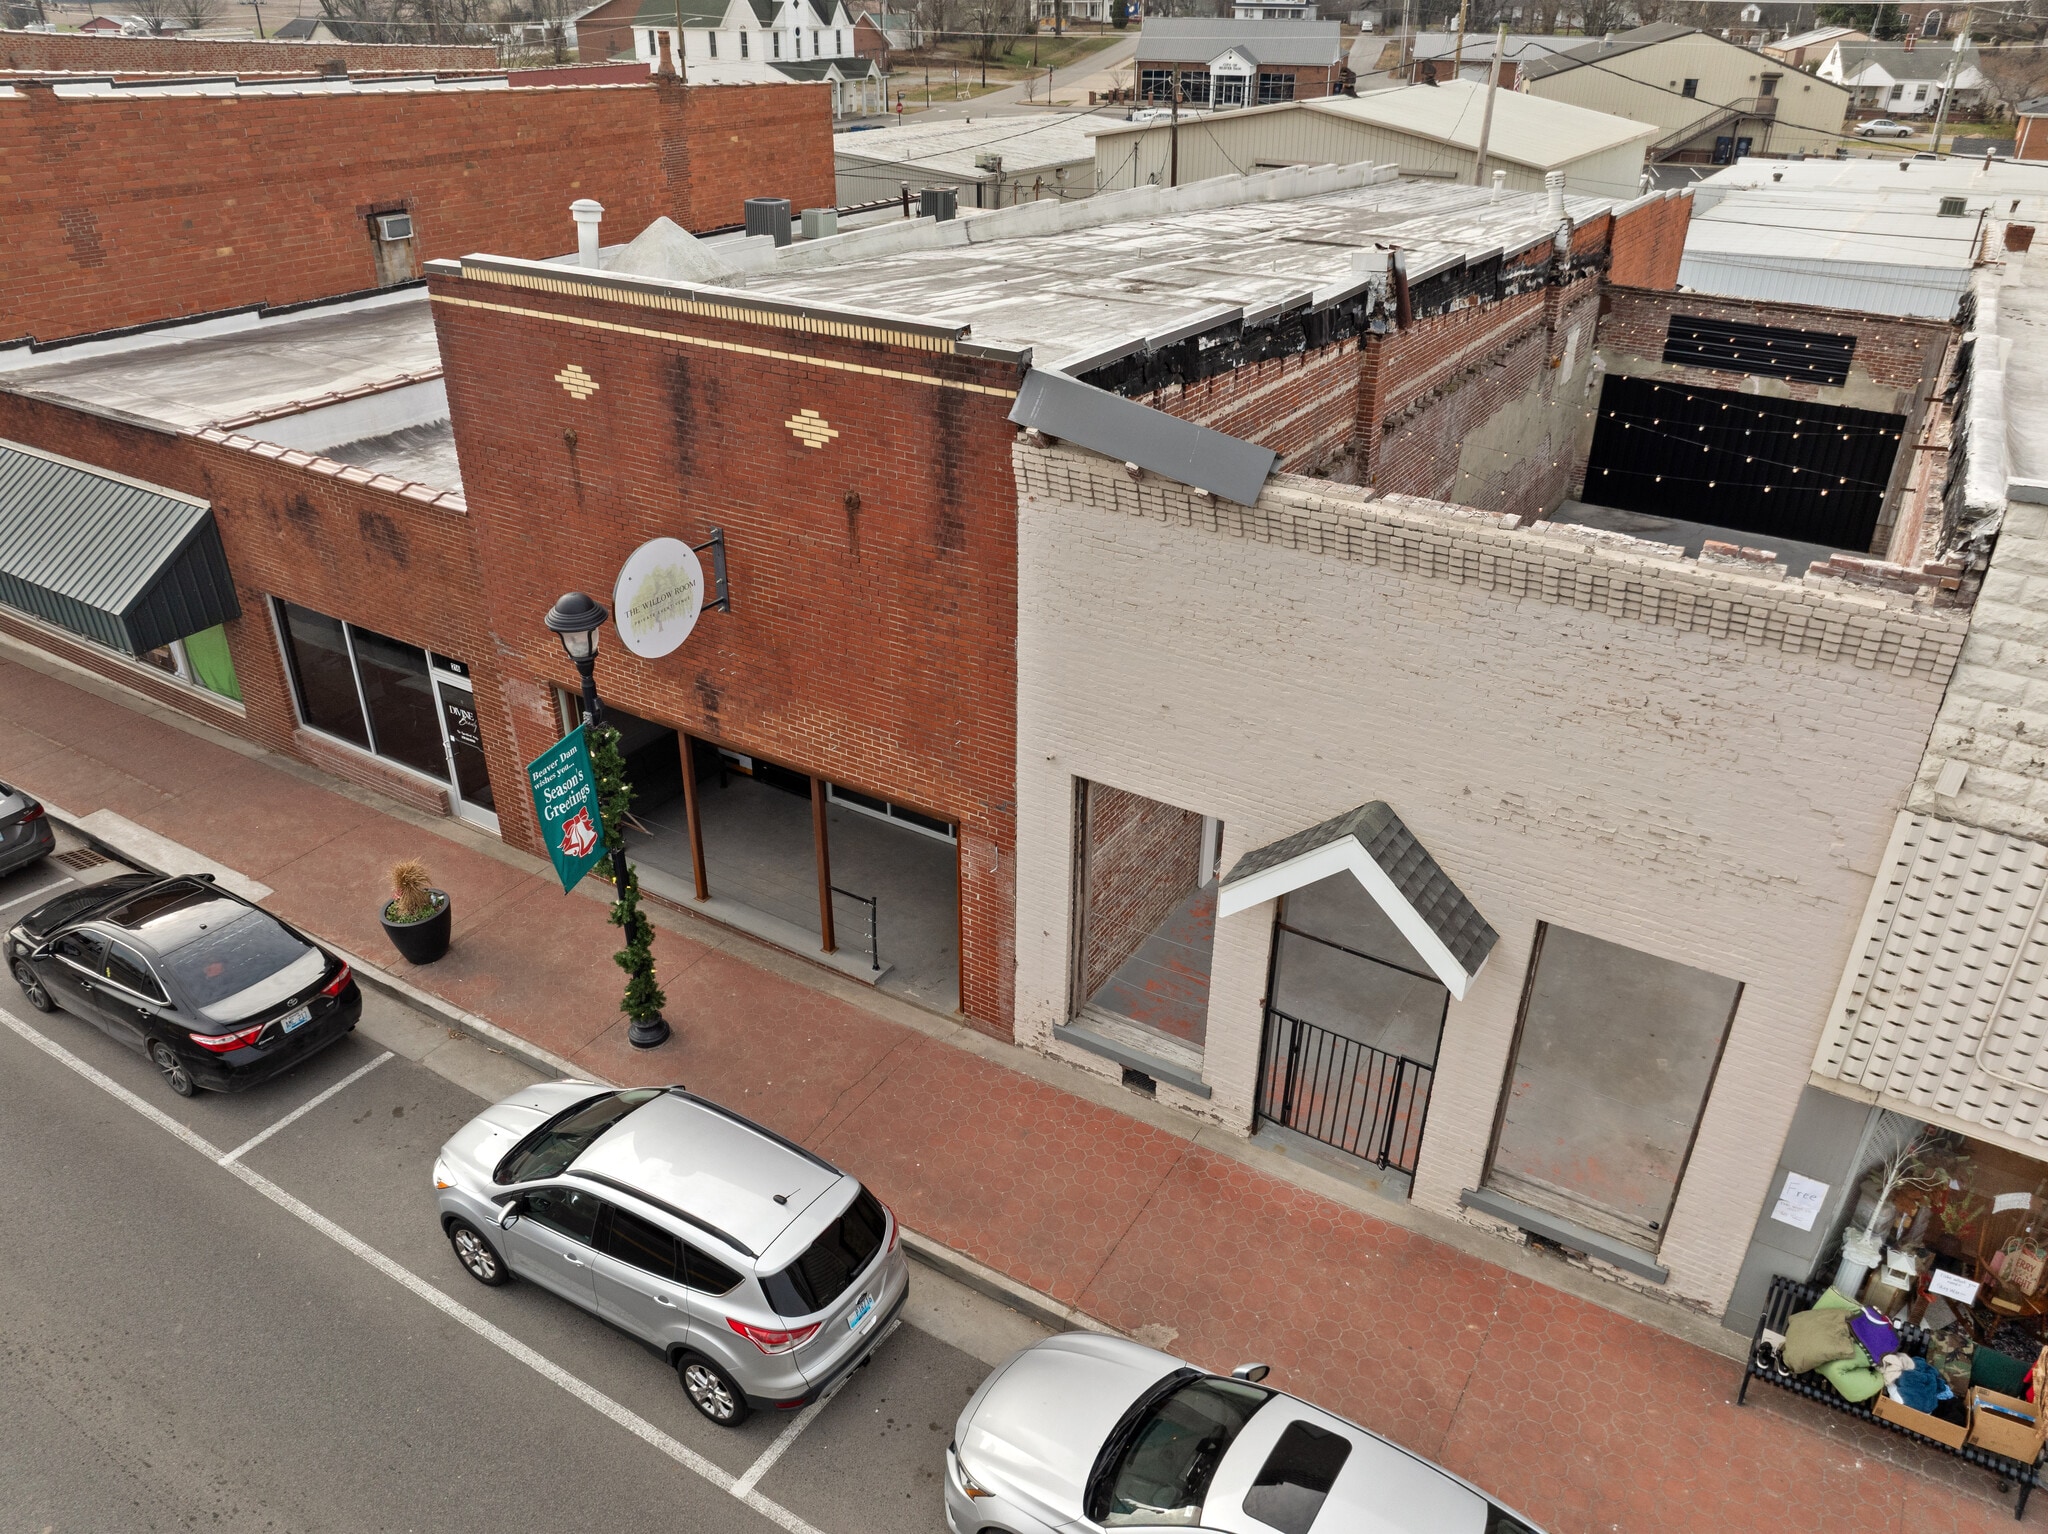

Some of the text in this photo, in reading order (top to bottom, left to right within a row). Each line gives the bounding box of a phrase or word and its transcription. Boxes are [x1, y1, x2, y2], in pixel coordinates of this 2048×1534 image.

[624, 579, 696, 618] THE WILLOW ROOM
[634, 613, 656, 626] PRIVATE
[449, 705, 475, 721] DIVINE
[532, 746, 578, 781] Beaver Dam
[533, 762, 575, 790] wishes you...
[543, 768, 584, 804] Season's
[544, 783, 590, 821] Greetings
[1787, 1182, 1817, 1201] Free
[2015, 1258, 2036, 1273] ERRY
